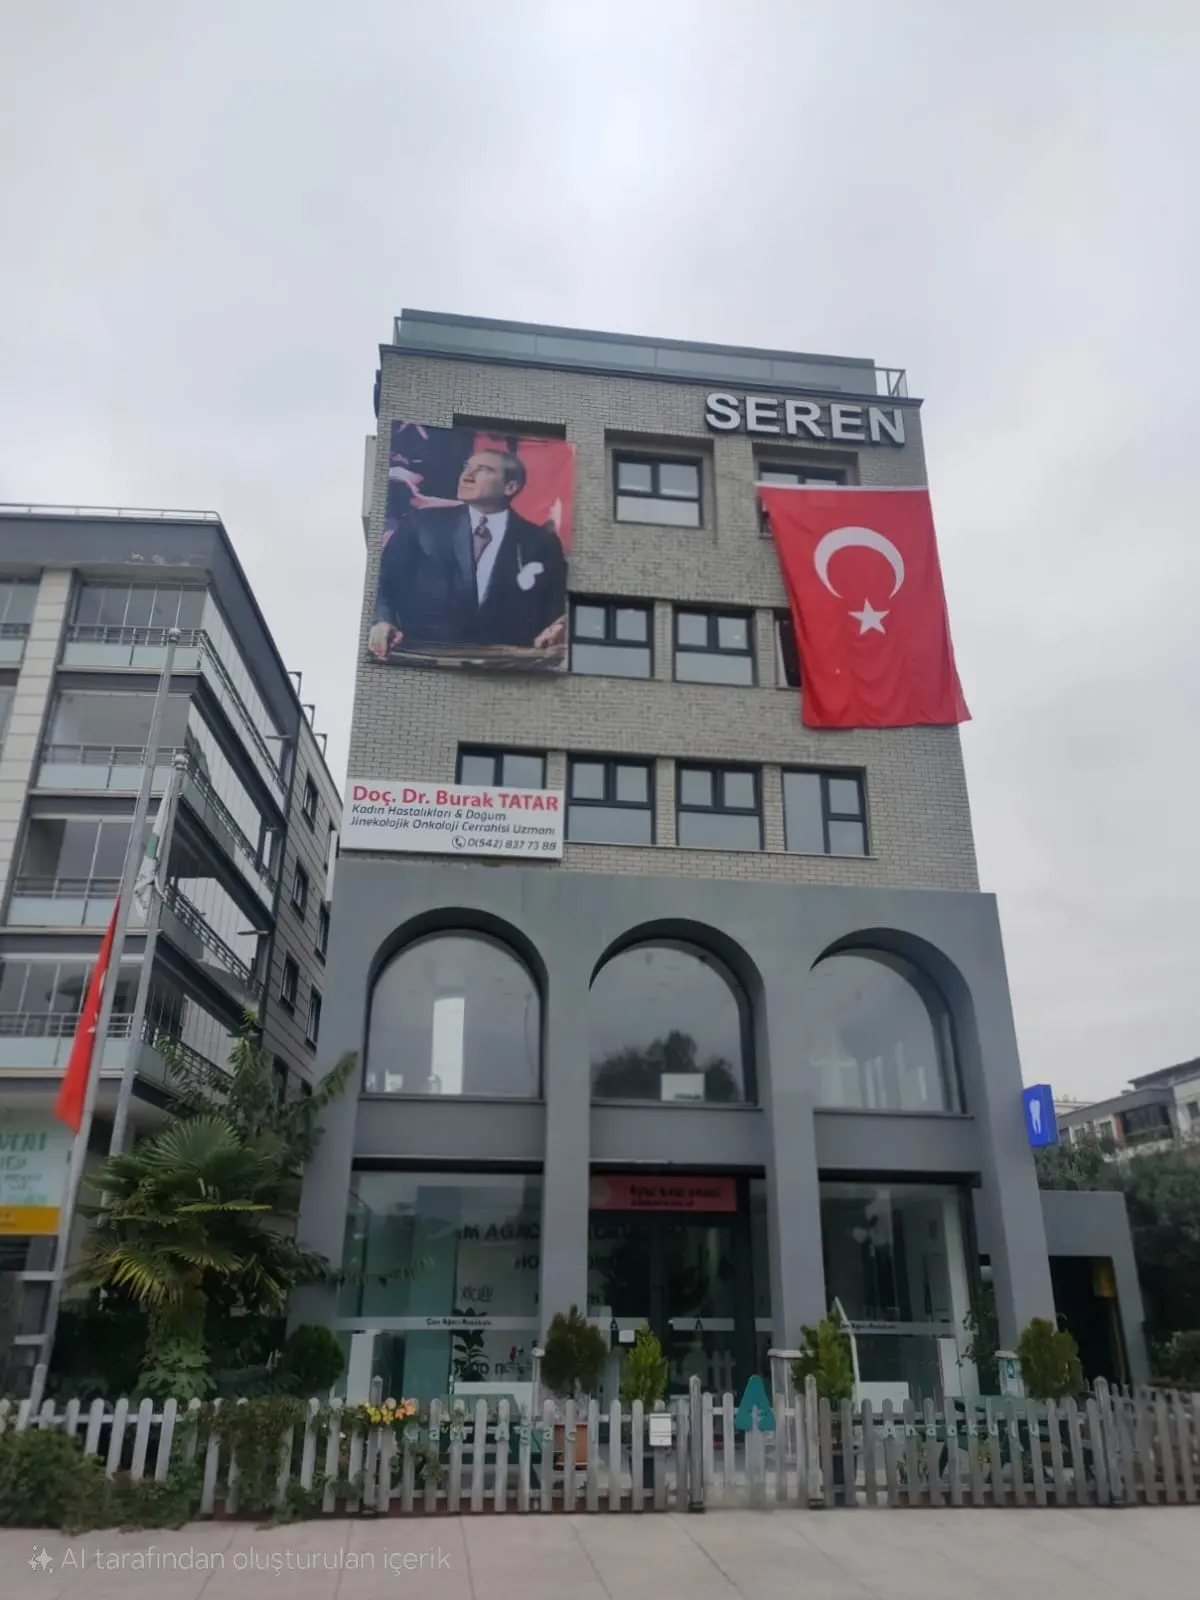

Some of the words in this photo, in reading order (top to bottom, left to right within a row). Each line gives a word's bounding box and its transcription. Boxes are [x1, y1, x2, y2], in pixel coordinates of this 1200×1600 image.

[705, 392, 906, 446] SEREN
[353, 785, 396, 806] Doç.
[402, 788, 430, 805] Dr.
[436, 790, 494, 808] Burak
[498, 793, 559, 811] TATAR
[352, 804, 385, 815] Kadın
[388, 806, 451, 818] Hastalıkları
[454, 808, 463, 819] &
[466, 809, 506, 822] Doğum
[350, 816, 410, 830] Jinekolojik
[413, 819, 459, 833] Onkoloji
[462, 821, 510, 833] Cerrahisi
[513, 824, 556, 836] Uzmanı
